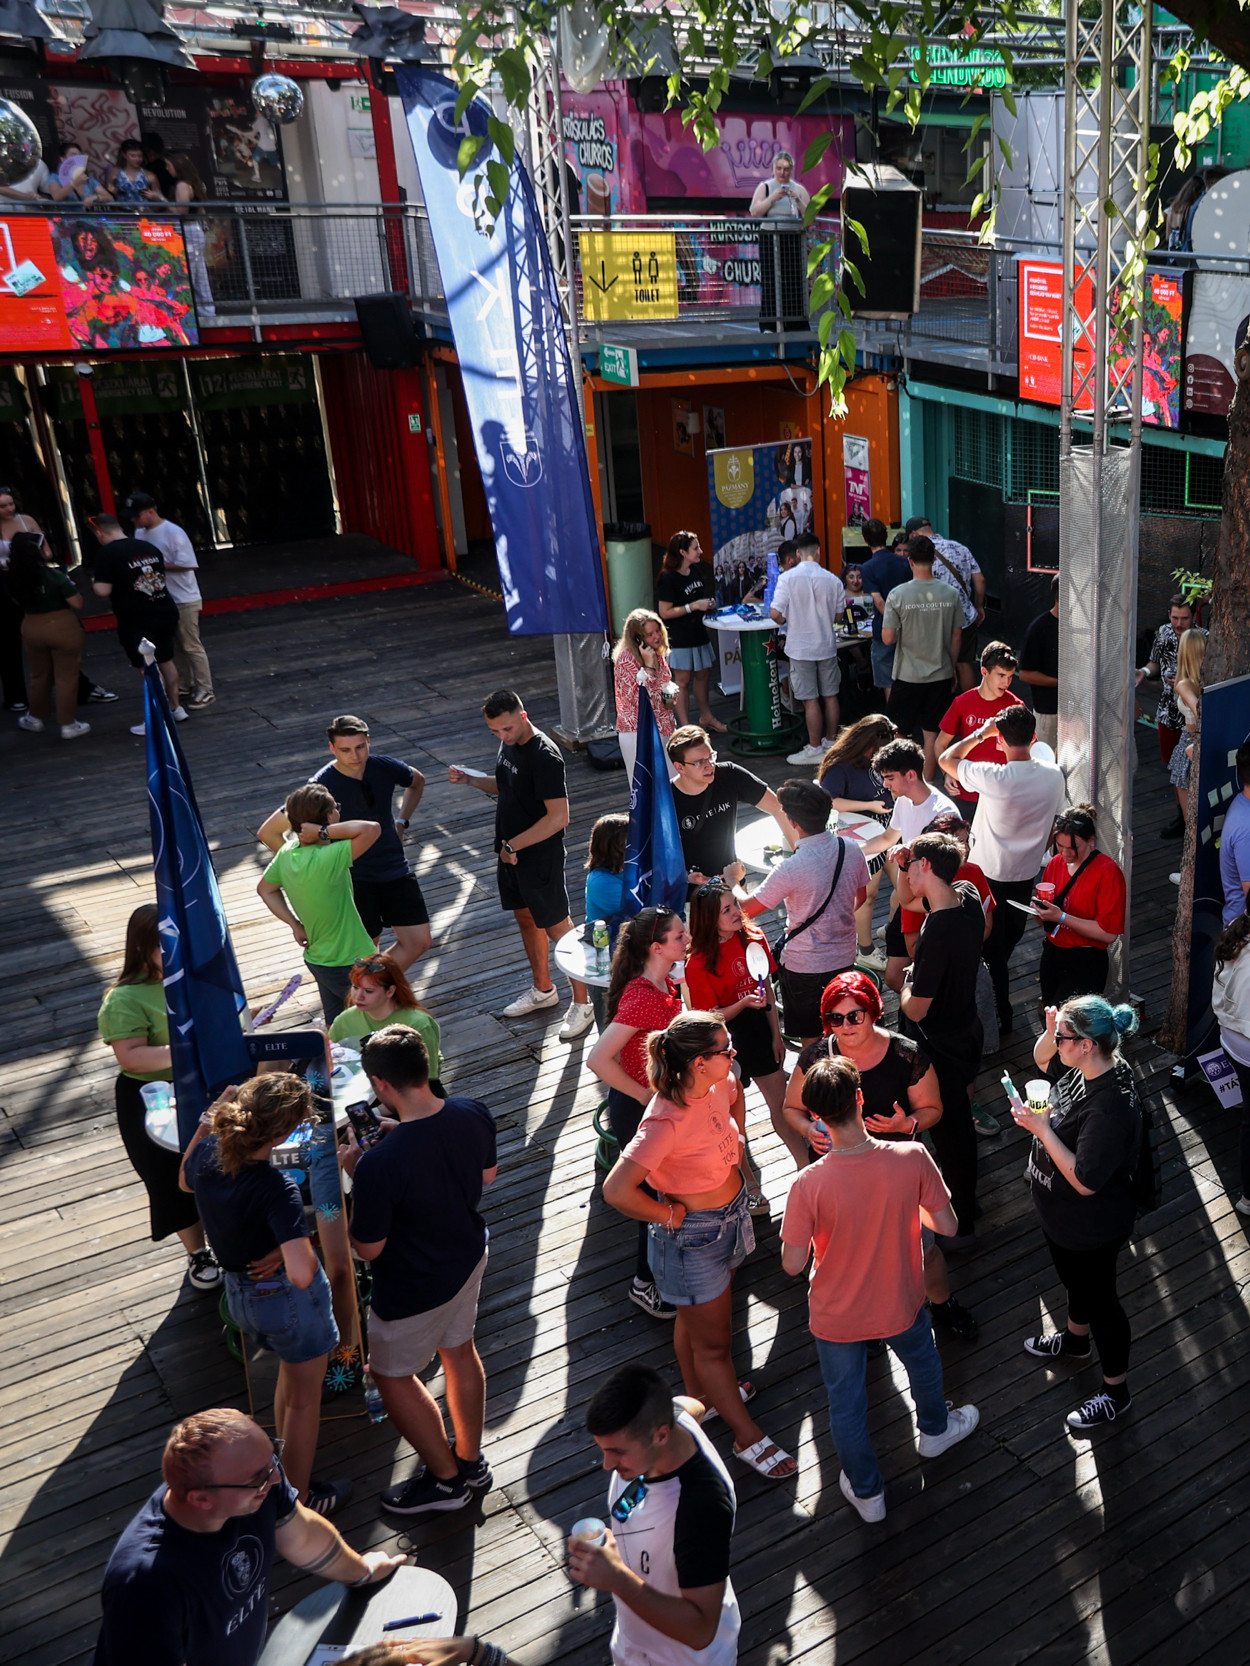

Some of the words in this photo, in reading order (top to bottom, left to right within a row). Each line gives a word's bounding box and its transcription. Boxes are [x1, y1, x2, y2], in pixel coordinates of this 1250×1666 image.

[4, 88, 34, 100] FUSION
[142, 108, 187, 119] REVOLUTION
[579, 143, 614, 171] CHURROS
[634, 289, 660, 303] TOILET
[604, 362, 616, 373] EXIT
[905, 602, 925, 611] ICONO
[771, 658, 782, 730] Heineken
[265, 1042, 288, 1051] ELTE
[717, 1132, 733, 1153] ELTE
[225, 1576, 267, 1637] ELTE
